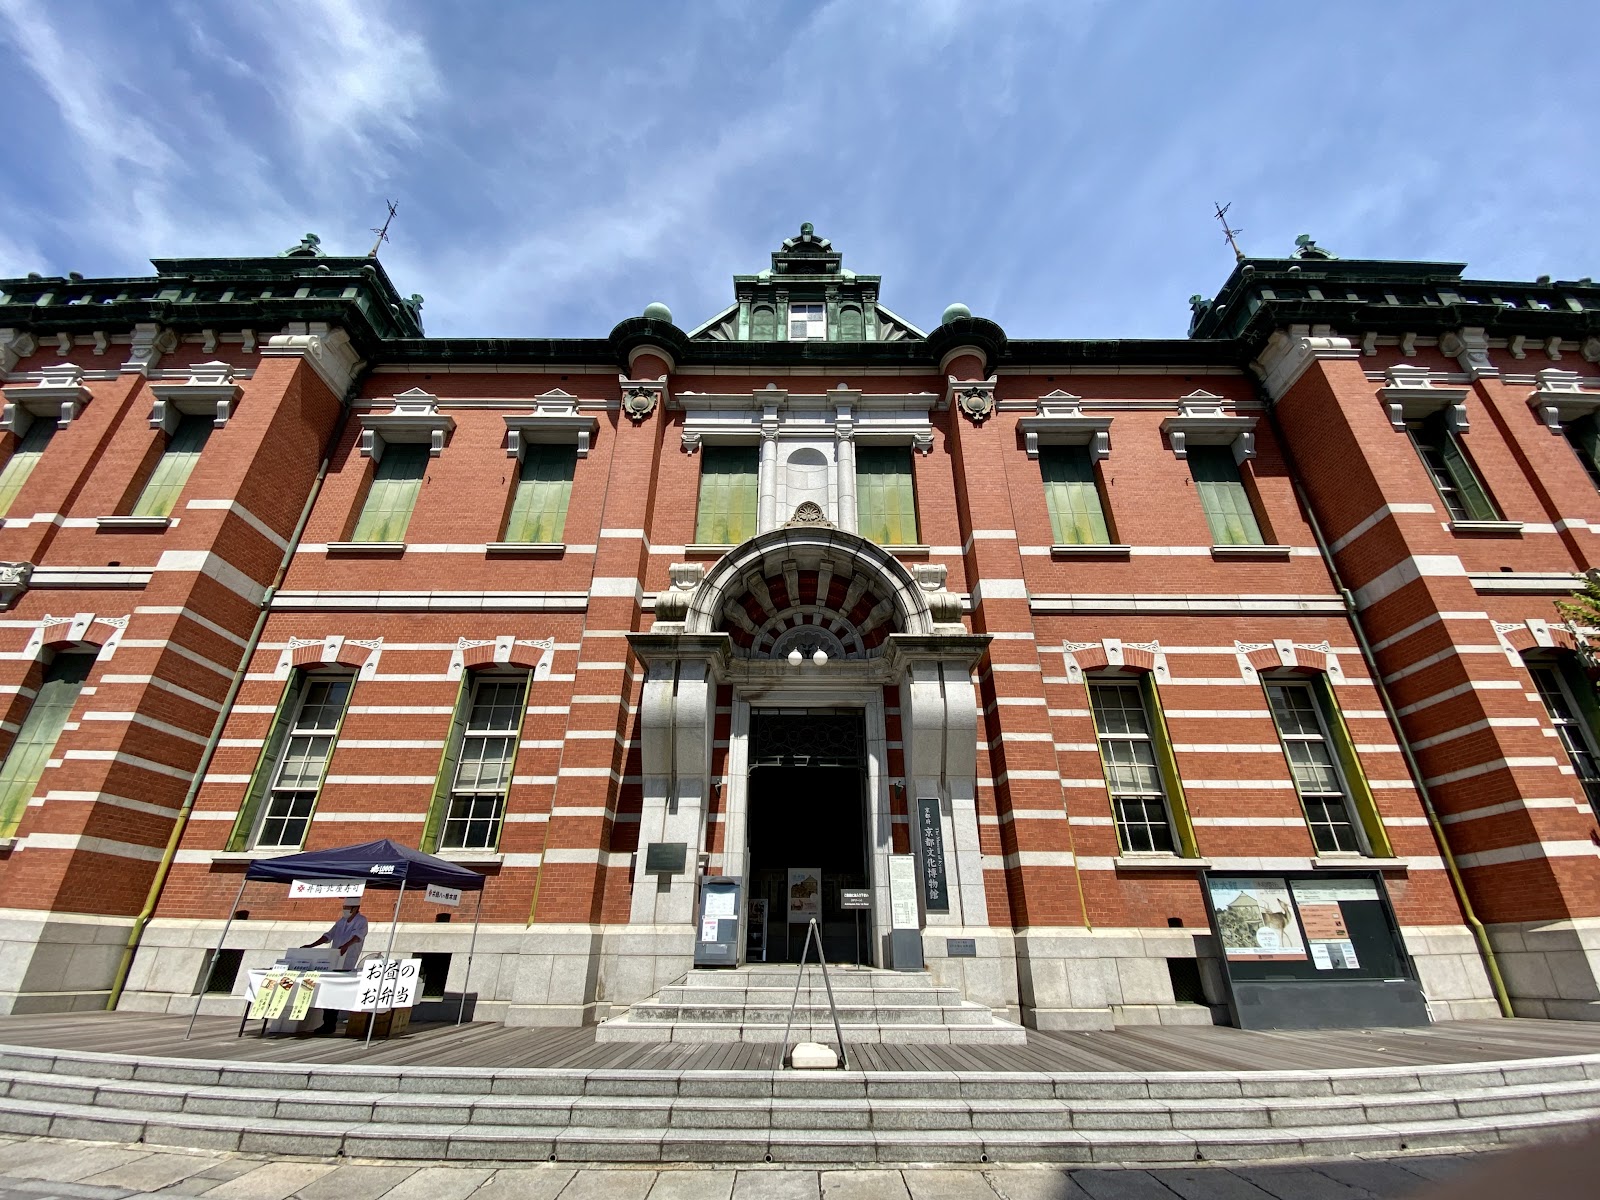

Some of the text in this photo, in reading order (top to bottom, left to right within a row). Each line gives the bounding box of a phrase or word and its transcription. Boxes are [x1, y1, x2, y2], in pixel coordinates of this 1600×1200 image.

[924, 826, 939, 900] 京都文化博物館
[366, 962, 415, 980] お昼の
[361, 987, 408, 1005] お弁当
